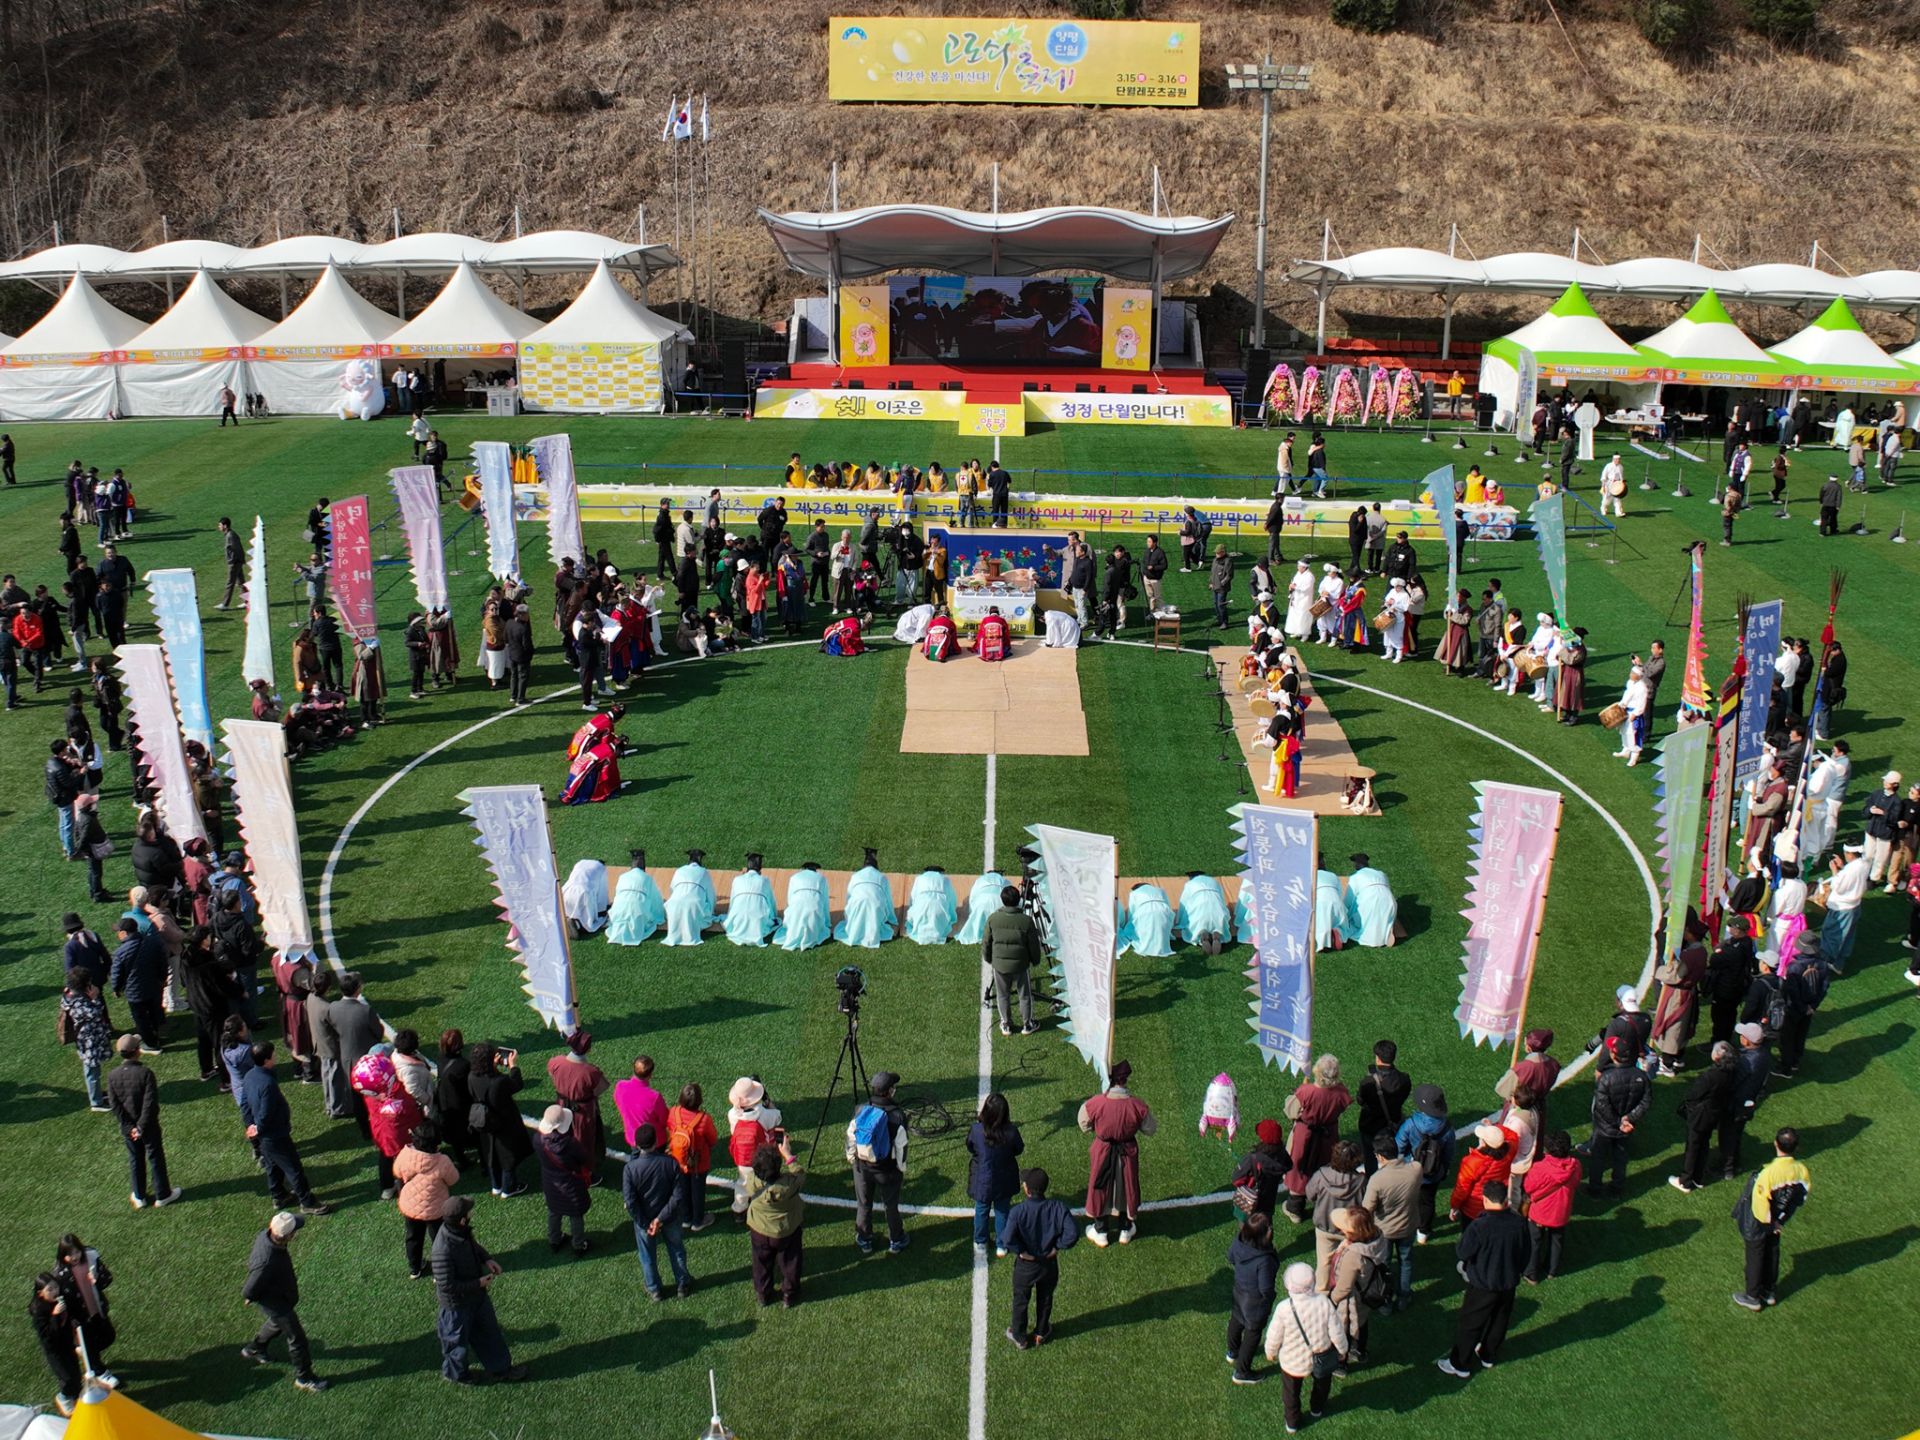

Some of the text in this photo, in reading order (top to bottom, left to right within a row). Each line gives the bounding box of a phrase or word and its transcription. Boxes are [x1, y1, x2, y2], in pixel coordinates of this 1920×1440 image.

[1055, 31, 1079, 44] 양평
[1055, 45, 1079, 57] 단월
[1116, 86, 1187, 97] 단월레포츠공원
[876, 400, 923, 415] 이곳은
[1061, 402, 1184, 419] 청정 단월입니다!
[795, 502, 848, 516] 제26회
[1012, 506, 1055, 522] 세상에서
[1082, 509, 1111, 524] 제일
[1120, 510, 1133, 524] 긴
